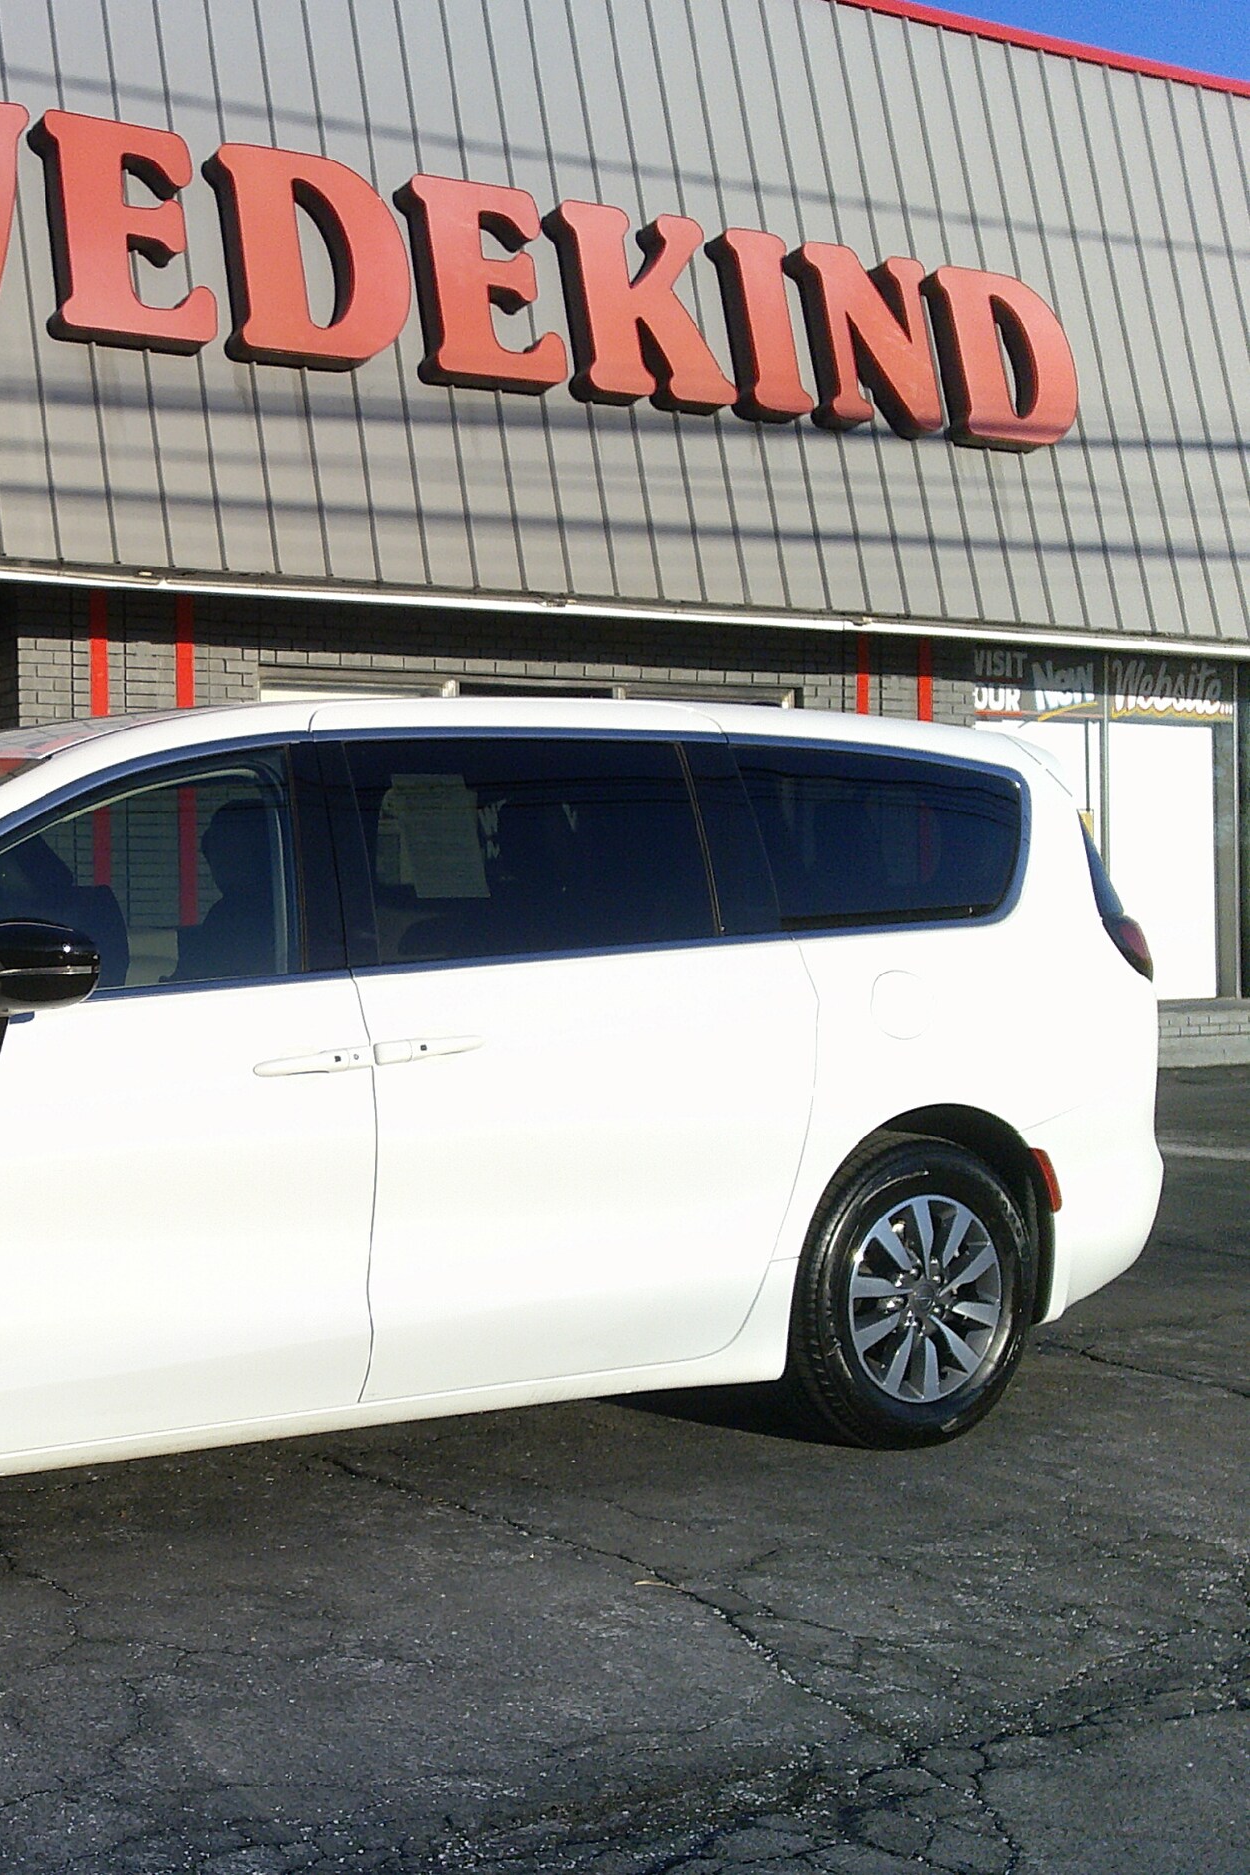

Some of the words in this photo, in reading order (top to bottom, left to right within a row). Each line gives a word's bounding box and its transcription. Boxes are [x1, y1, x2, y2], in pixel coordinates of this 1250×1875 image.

[973, 650, 1028, 678] VISIT
[972, 682, 1021, 712] OUR
[1031, 659, 1095, 714] New
